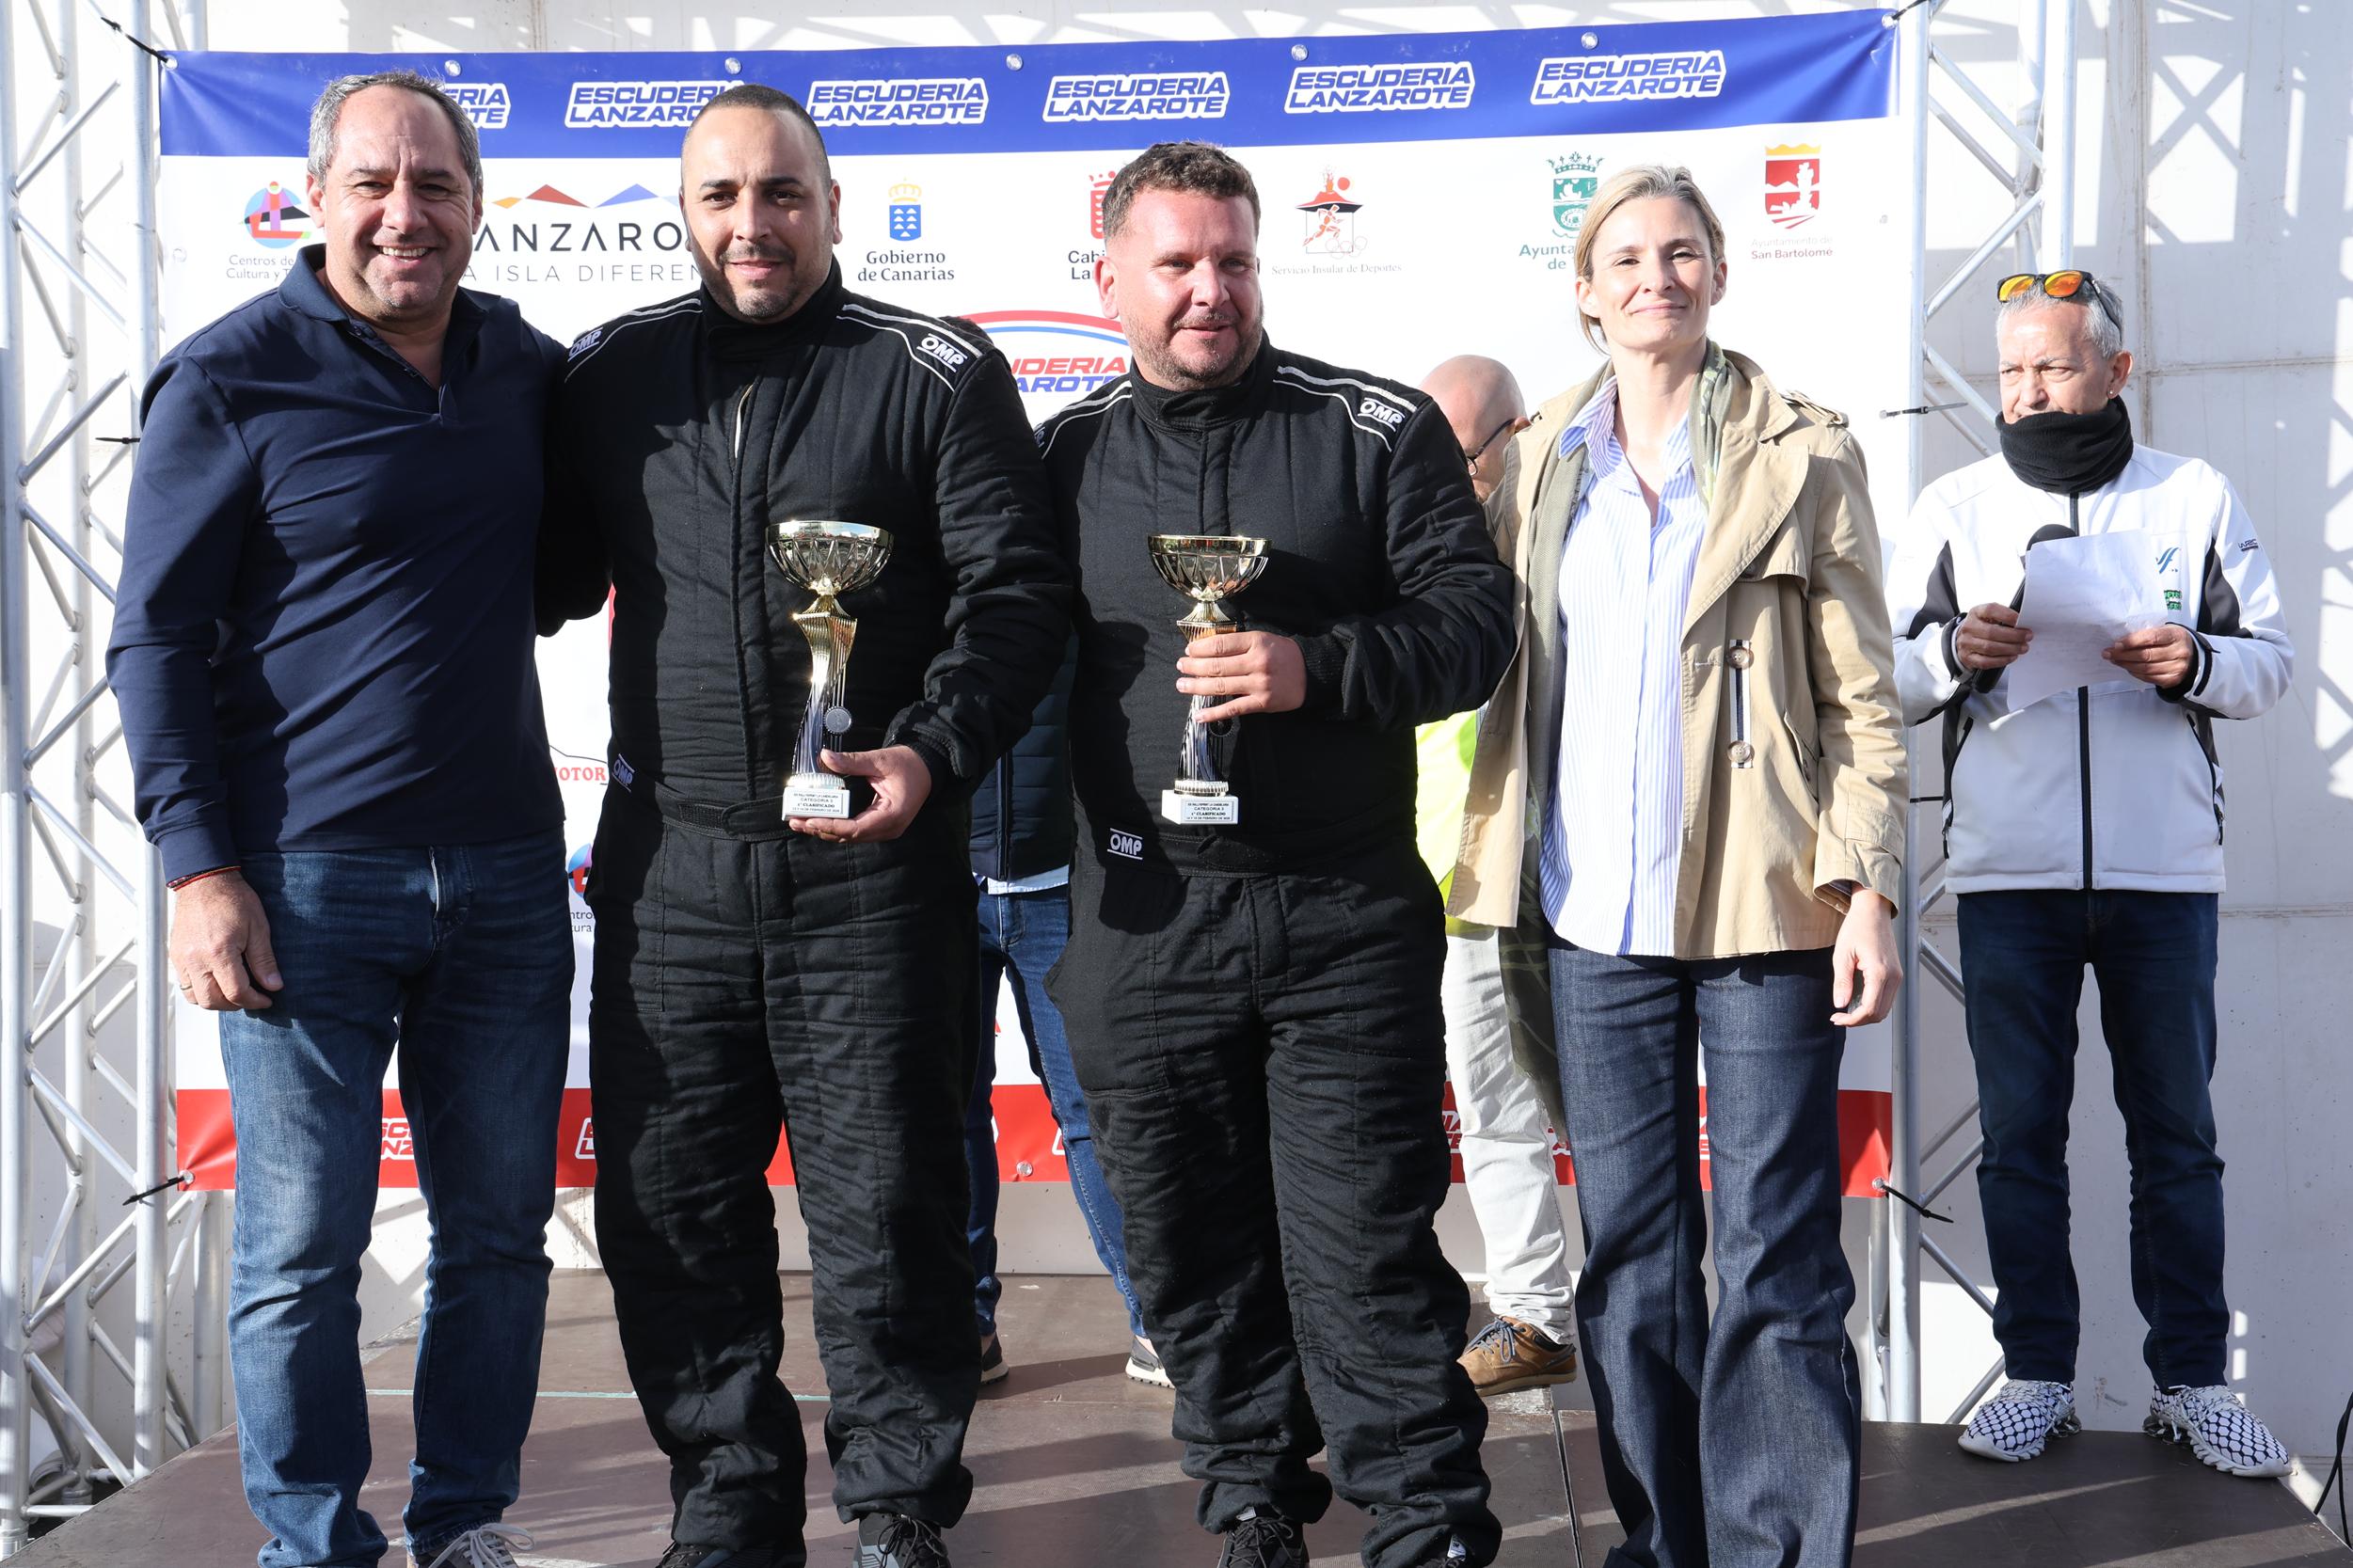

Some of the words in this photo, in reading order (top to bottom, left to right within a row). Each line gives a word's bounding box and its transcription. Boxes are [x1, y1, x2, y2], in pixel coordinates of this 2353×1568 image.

[1294, 67, 1471, 89] ESCUDERIA
[1541, 55, 1722, 81] ESCUDERIA
[812, 83, 984, 103] ESCUDERIA
[1052, 77, 1226, 98] ESCUDERIA
[1289, 86, 1470, 108] LANZAROTE
[1534, 74, 1721, 100] LANZAROTE
[809, 102, 983, 121] LANZAROTE
[1047, 96, 1225, 117] LANZAROTE
[473, 221, 682, 252] ANZARO
[229, 254, 277, 266] Centros
[280, 255, 294, 266] de
[866, 249, 946, 264] Gobierno
[1518, 244, 1575, 260] Ayunta
[1751, 250, 1772, 260] San
[496, 264, 561, 282] ISLA
[579, 263, 702, 282] DIFEREN
[857, 267, 877, 281] de
[881, 266, 955, 281] Canarias
[1271, 265, 1310, 275] Servicio
[1312, 264, 1343, 274] Insular
[1347, 264, 1358, 273] de
[1360, 263, 1402, 274] Deportes
[1548, 258, 1566, 270] de
[226, 267, 270, 279] Cultura
[274, 271, 280, 282] y
[569, 330, 602, 356] OMP
[921, 337, 964, 365] OMP
[1359, 401, 1403, 424] OMP
[556, 767, 607, 781] OTOR
[613, 759, 633, 786] OMP
[1109, 833, 1143, 856] OMP
